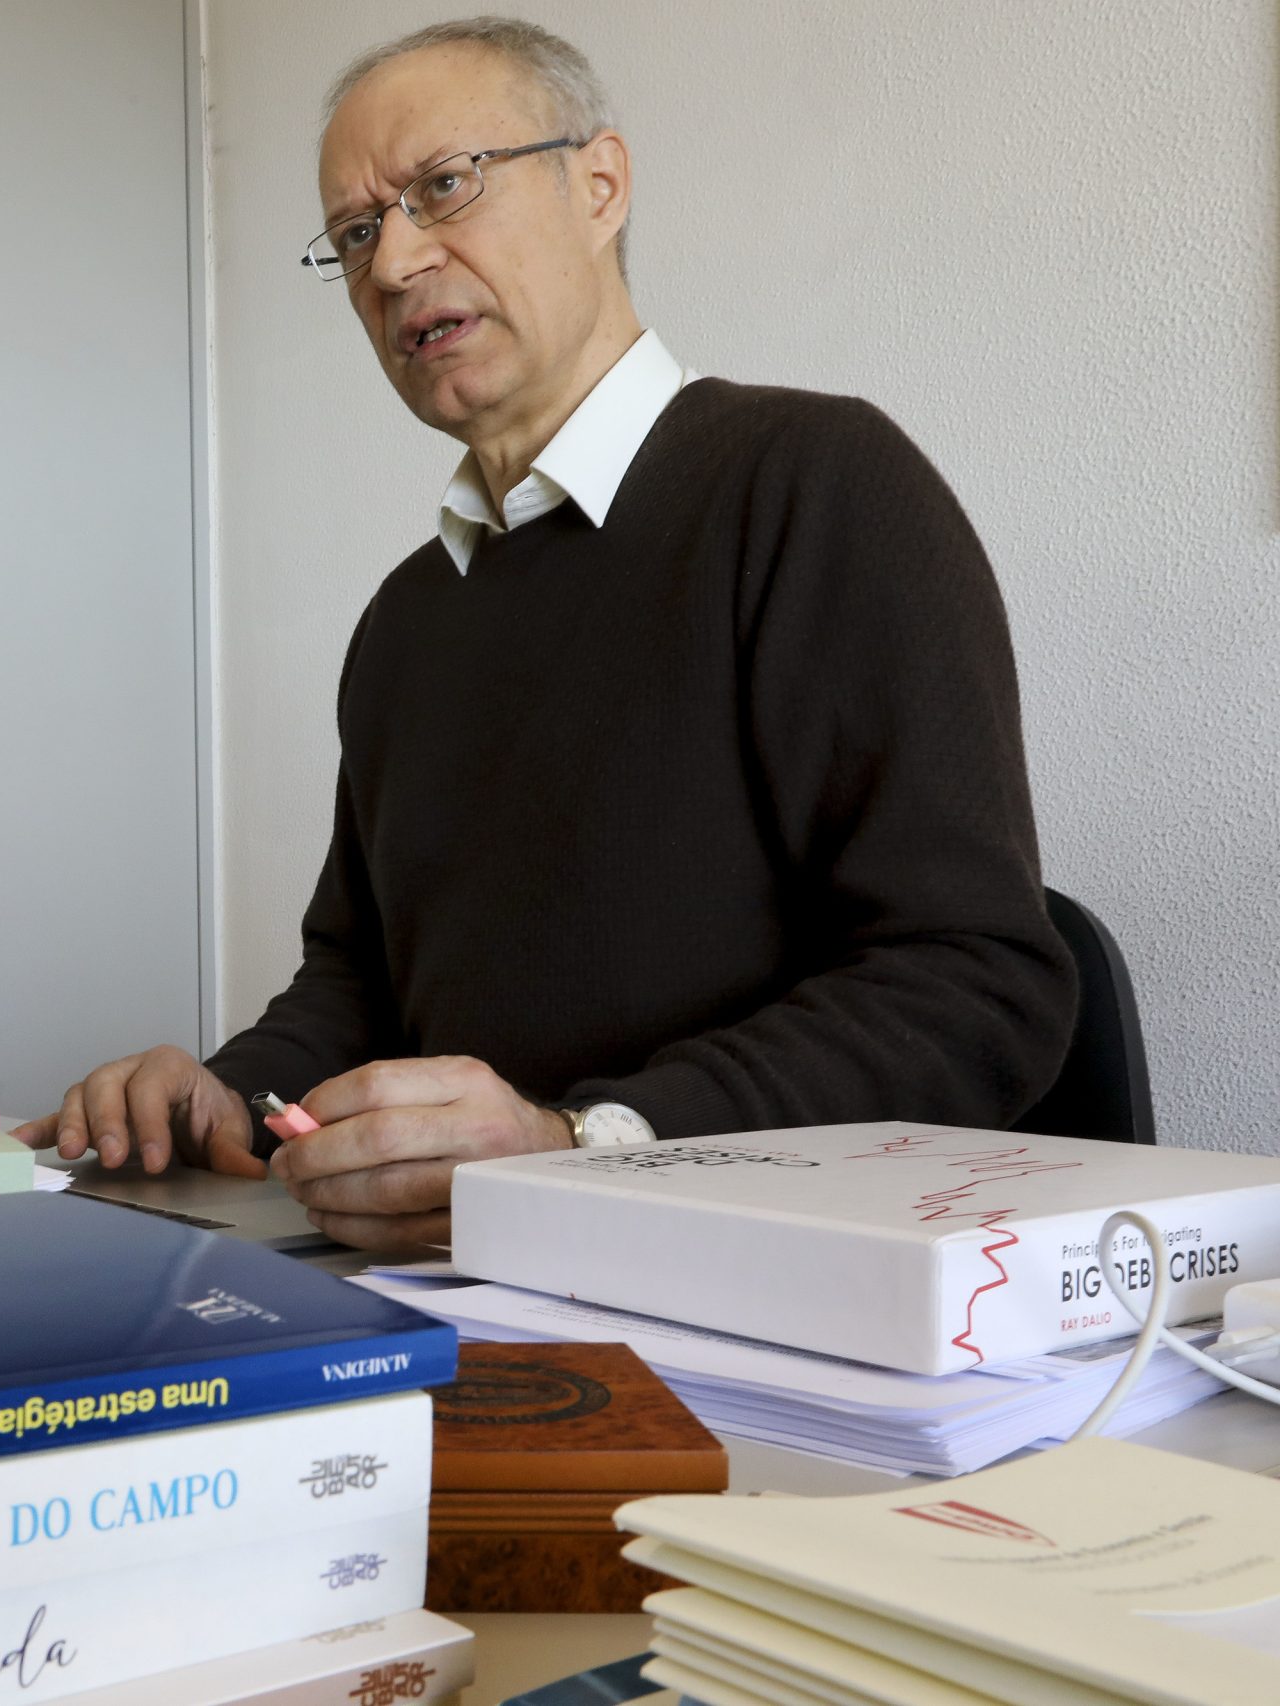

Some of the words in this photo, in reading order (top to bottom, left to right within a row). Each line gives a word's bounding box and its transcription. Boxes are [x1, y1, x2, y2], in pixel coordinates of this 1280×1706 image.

[1122, 1235, 1139, 1250] For
[1061, 1266, 1102, 1302] BIG
[1169, 1243, 1239, 1283] CRISES
[1061, 1318, 1078, 1332] RAY
[1083, 1311, 1112, 1327] DALIO
[321, 1352, 413, 1382] ALMEDINA
[162, 1377, 229, 1410] Uma
[9, 1495, 72, 1548] DO
[89, 1468, 240, 1533] CAMPO
